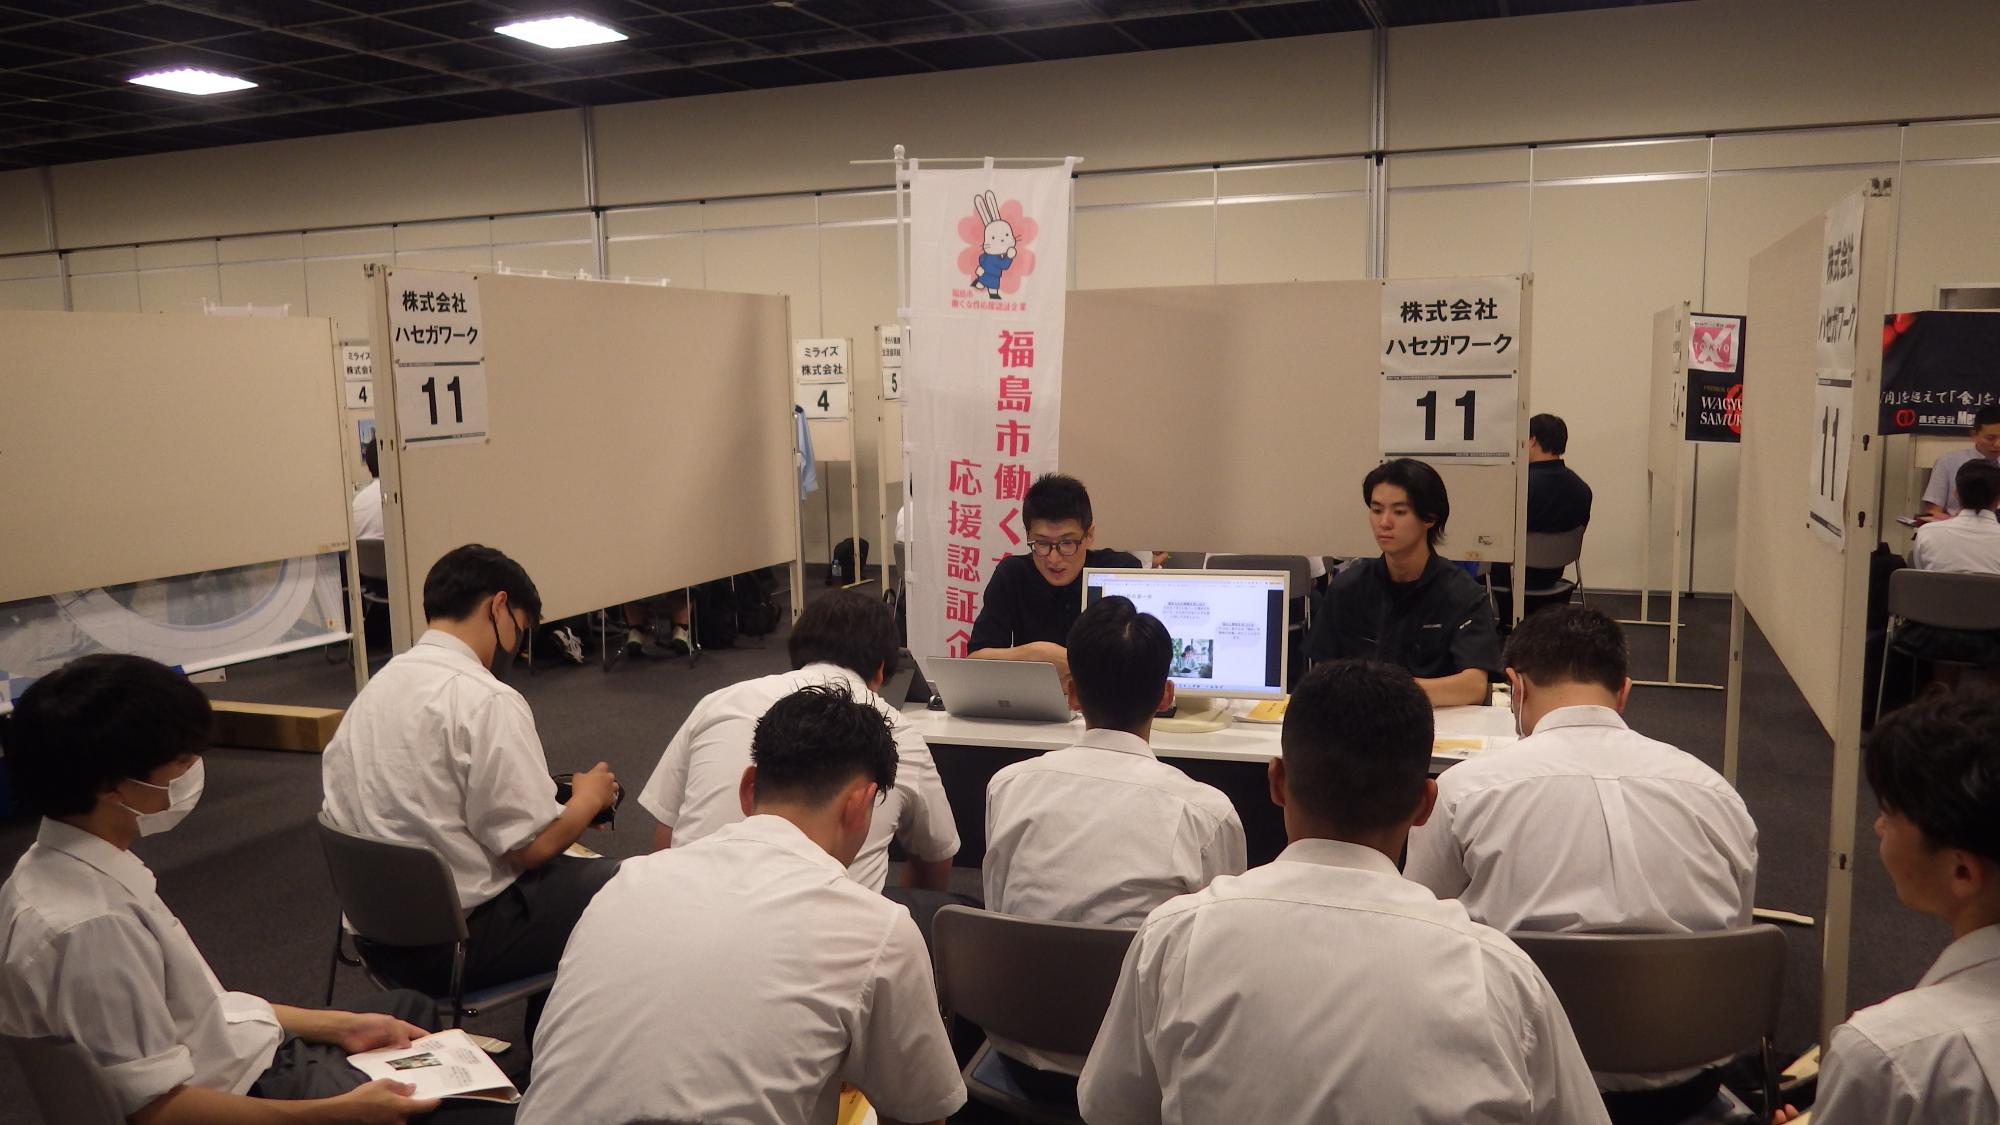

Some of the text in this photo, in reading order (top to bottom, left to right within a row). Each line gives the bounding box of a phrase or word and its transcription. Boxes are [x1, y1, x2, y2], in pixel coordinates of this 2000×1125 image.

[402, 290, 467, 313] 株式会社
[1400, 298, 1498, 323] 株式会社
[395, 325, 479, 345] ハセガワーク
[1386, 333, 1513, 356] ハセガワーク
[804, 345, 839, 358] ミライズ
[801, 364, 843, 376] 株式会社
[359, 386, 367, 403] 4
[891, 373, 898, 393] 5
[421, 376, 463, 425] 11
[817, 389, 830, 412] 4
[1416, 390, 1476, 441] 11
[991, 330, 1034, 563] 福島市働く
[1821, 406, 1839, 501] 11
